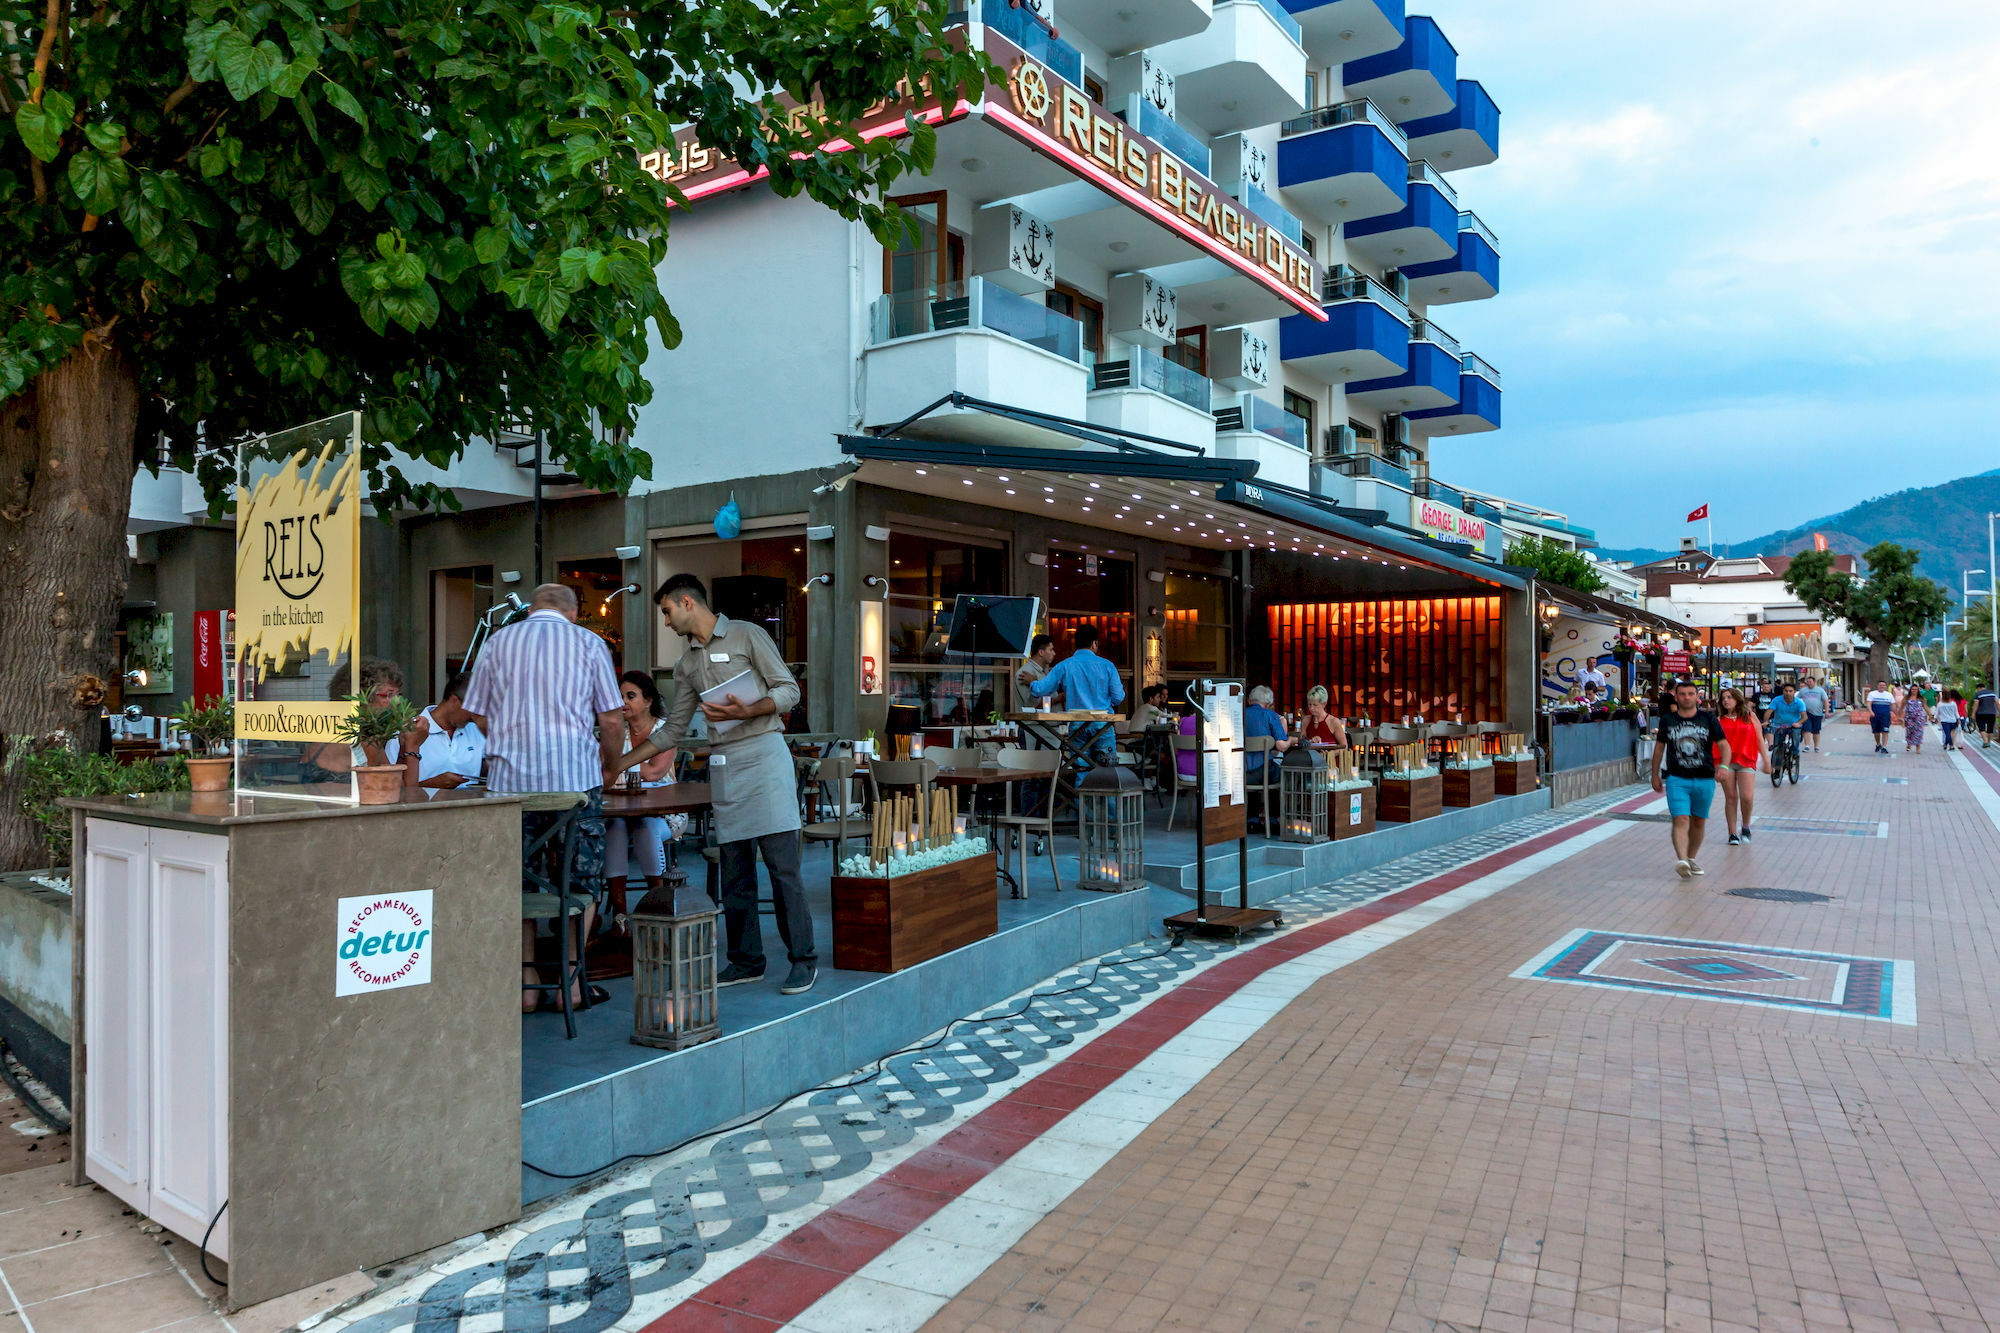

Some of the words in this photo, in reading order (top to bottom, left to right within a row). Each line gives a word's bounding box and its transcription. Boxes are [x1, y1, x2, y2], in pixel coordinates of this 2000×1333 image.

[1160, 151, 1257, 258] BEACH
[1266, 226, 1321, 302] OTEL
[1422, 502, 1452, 531] GEORGE
[1458, 517, 1486, 541] DRAGON
[262, 513, 325, 600] REIS
[262, 609, 271, 626] in
[273, 605, 288, 626] the
[289, 603, 324, 625] kitchen
[244, 704, 341, 735] FOOD&GROOVE
[348, 899, 422, 934] RECOMMENDED
[339, 929, 430, 960] detur
[349, 952, 420, 985] RECOMMENDED
